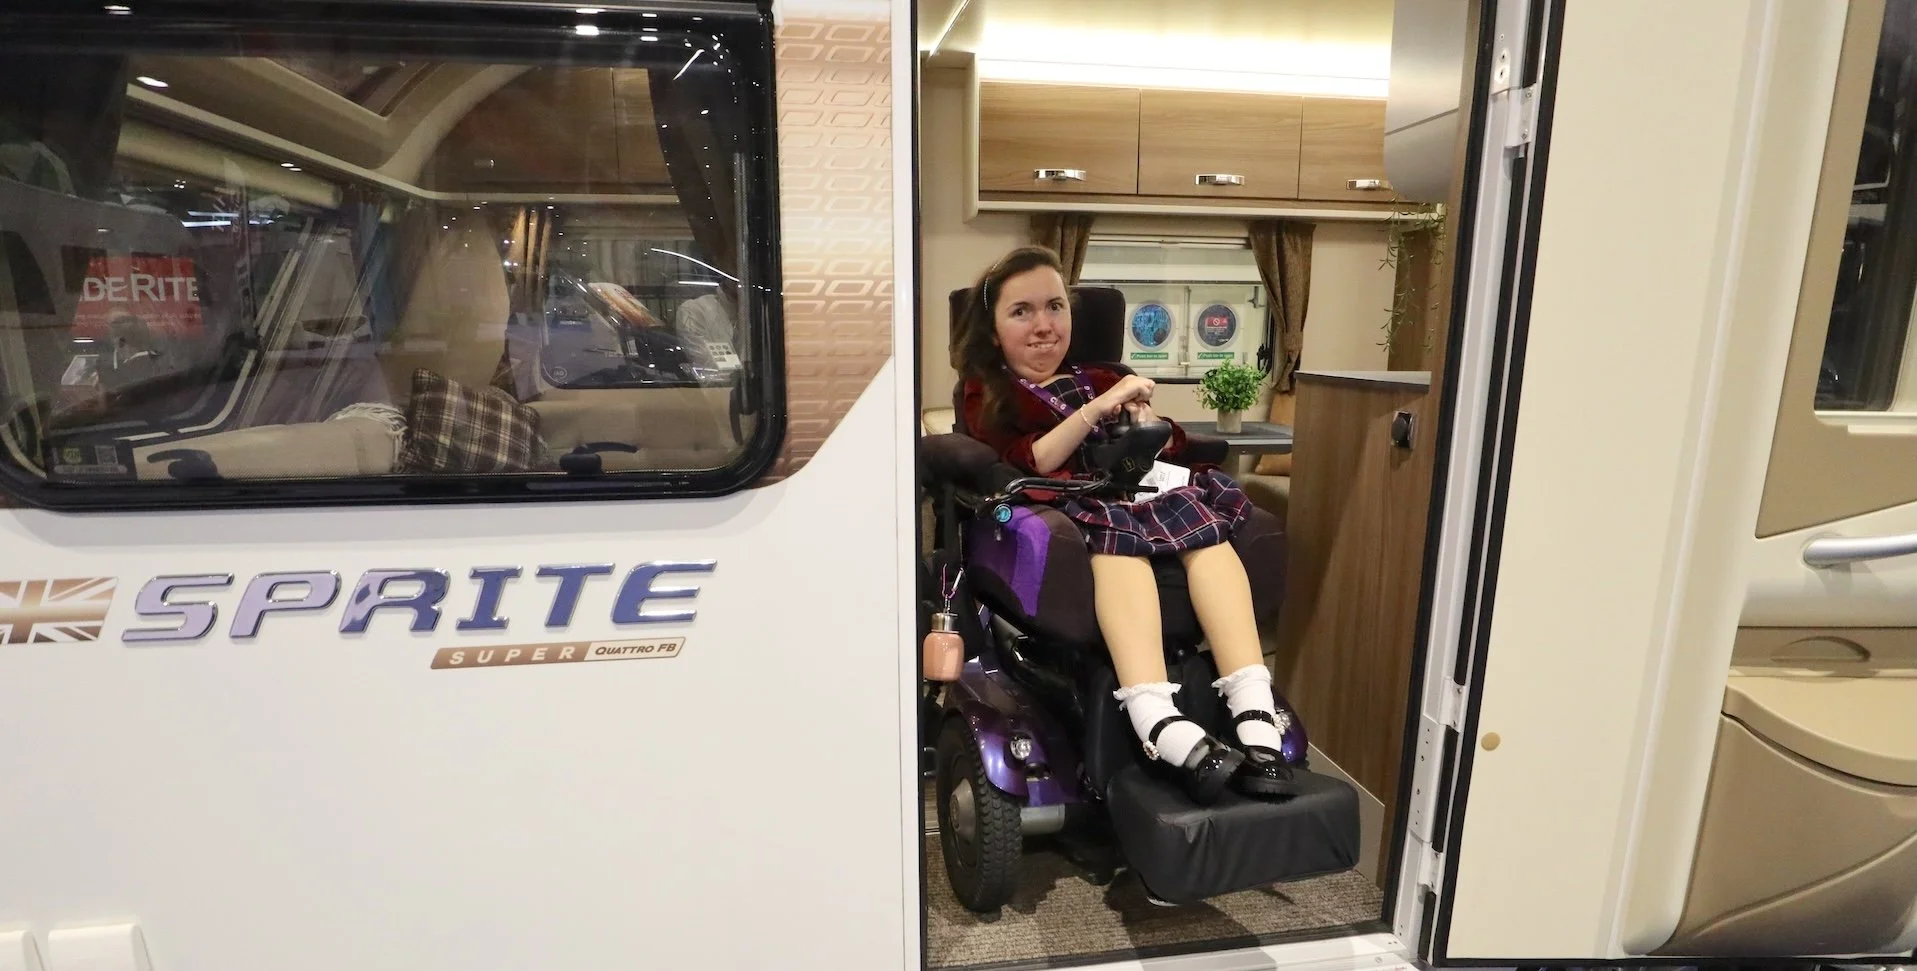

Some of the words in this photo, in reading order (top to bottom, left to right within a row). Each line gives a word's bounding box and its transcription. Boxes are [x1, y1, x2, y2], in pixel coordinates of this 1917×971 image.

[79, 273, 200, 302] DERITE
[121, 559, 717, 642] SPRITE
[449, 646, 576, 665] SUPER
[594, 645, 655, 656] QUATTRO
[657, 643, 677, 653] FB
